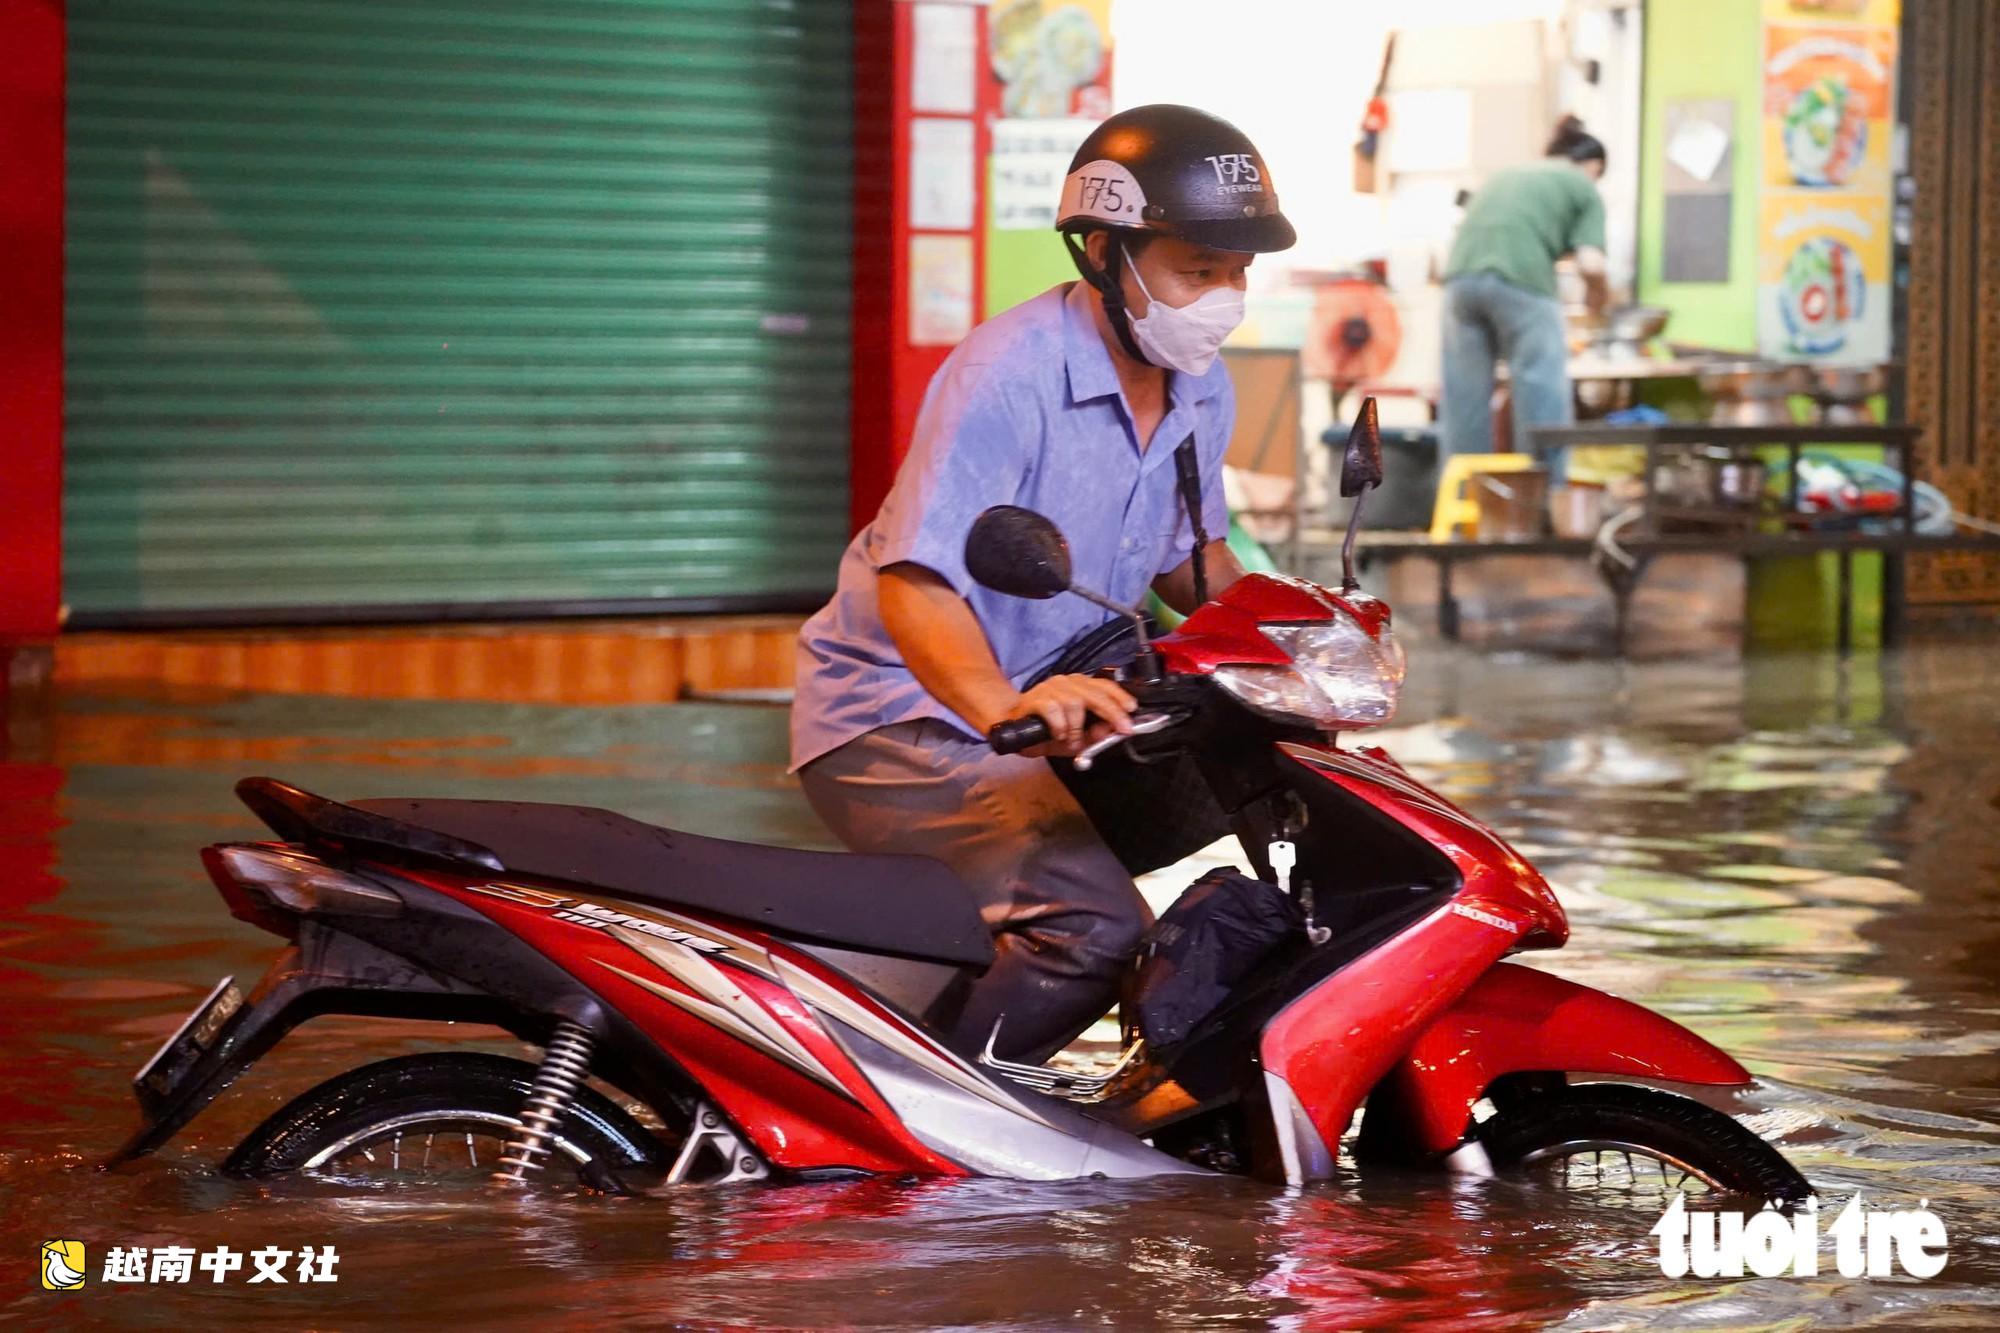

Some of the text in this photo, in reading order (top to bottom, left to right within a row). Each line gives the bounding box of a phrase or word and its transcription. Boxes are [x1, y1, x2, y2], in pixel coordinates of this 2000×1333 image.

[1204, 153, 1260, 184] 175
[1079, 176, 1125, 213] 175
[1216, 184, 1263, 196] EYEWEAR
[1451, 902, 1519, 935] HONDA
